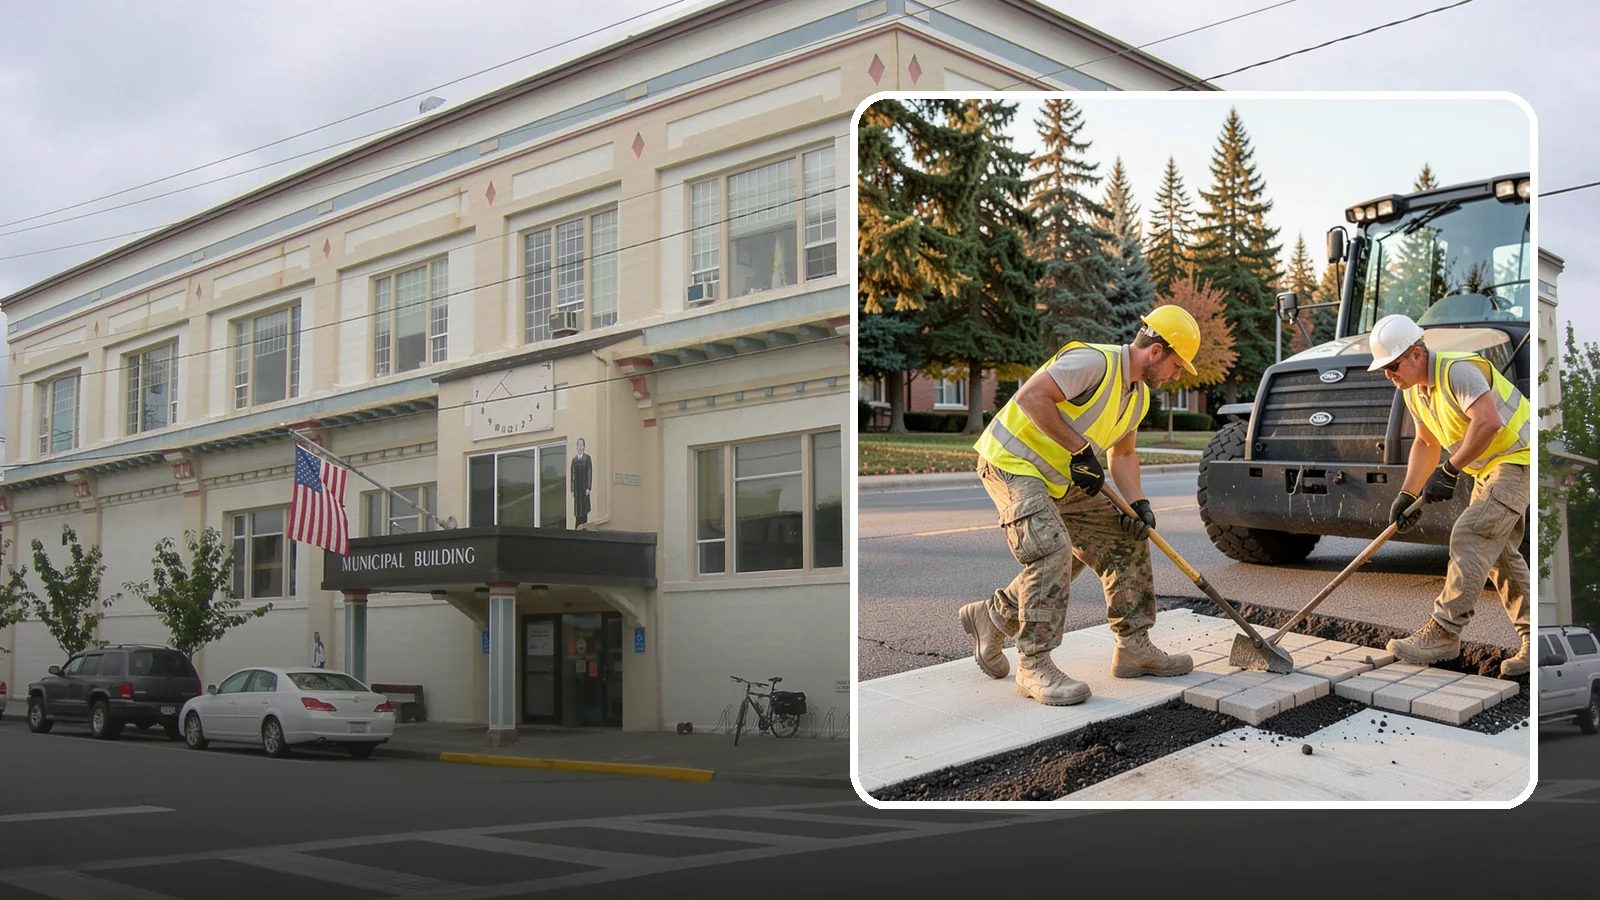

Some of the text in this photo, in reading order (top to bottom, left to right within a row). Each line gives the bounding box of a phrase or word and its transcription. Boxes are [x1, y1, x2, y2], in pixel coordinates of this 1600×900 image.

[494, 423, 500, 432] 10
[507, 425, 513, 433] 12
[342, 546, 475, 571] MUNICIPAL BUILDING
